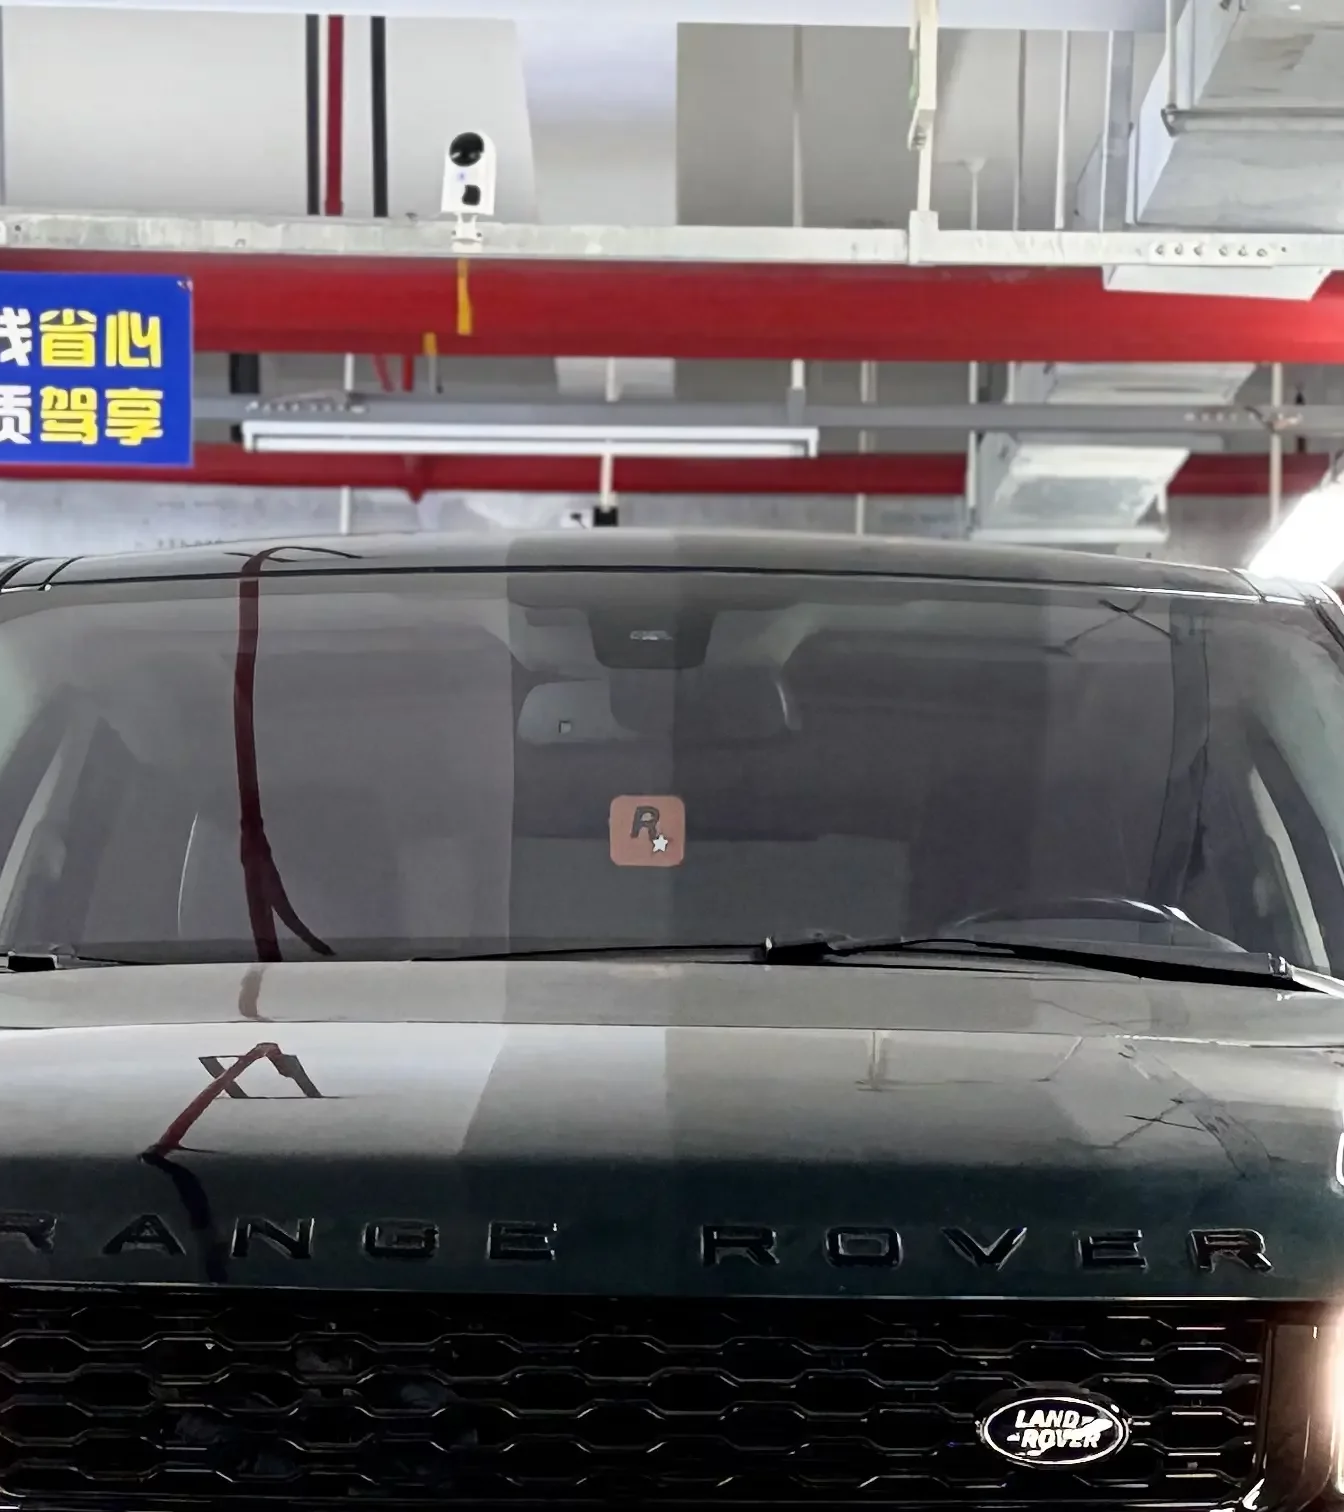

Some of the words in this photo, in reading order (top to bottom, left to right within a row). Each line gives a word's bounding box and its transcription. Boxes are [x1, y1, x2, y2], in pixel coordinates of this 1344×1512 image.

[698, 1224, 1274, 1275] ROVER
[1015, 1409, 1081, 1429] LAND
[1020, 1428, 1101, 1449] ROVER
